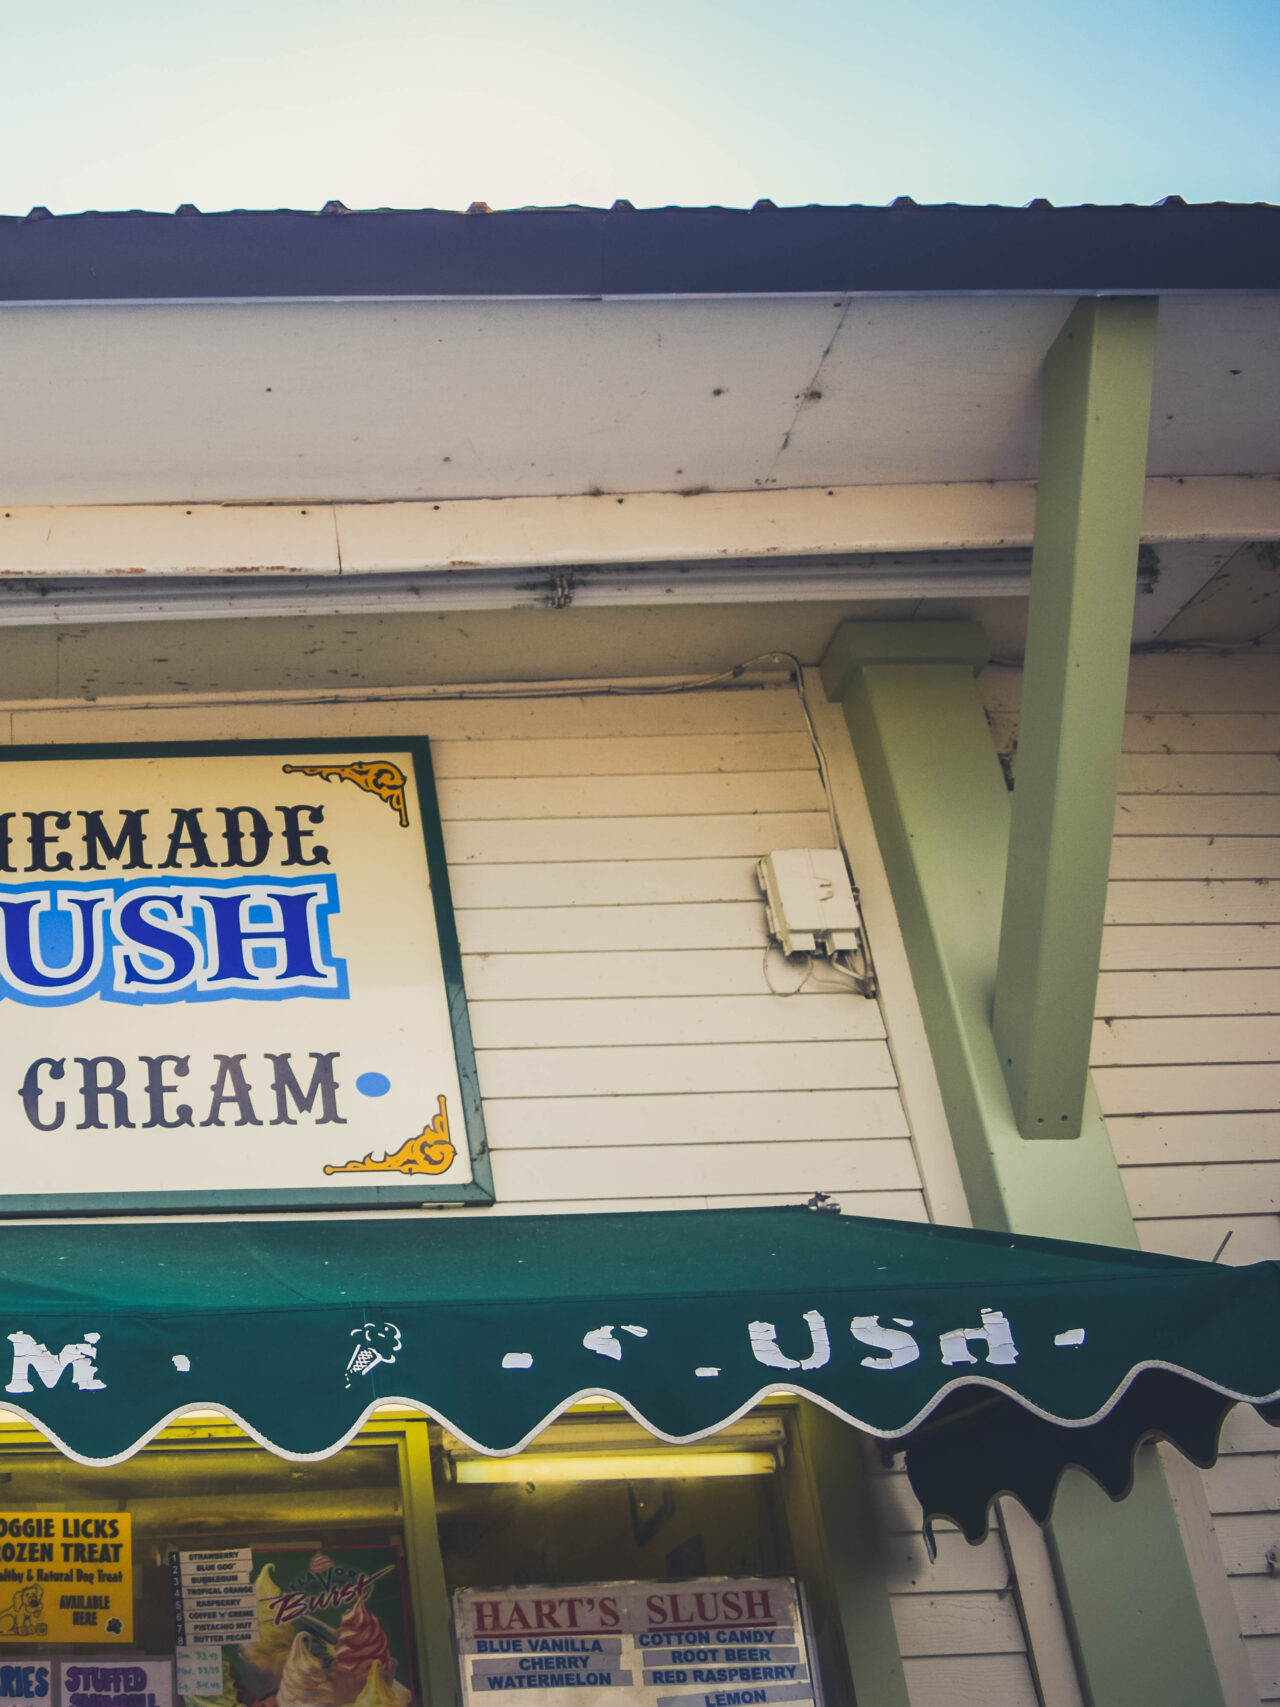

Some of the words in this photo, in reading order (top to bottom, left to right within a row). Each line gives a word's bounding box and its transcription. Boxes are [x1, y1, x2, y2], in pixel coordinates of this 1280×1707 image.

[17, 1051, 348, 1132] CREAM
[62, 1518, 120, 1539] LICKS
[60, 1543, 123, 1563] TREAT
[188, 1551, 239, 1561] STRAWBERRY
[26, 1568, 34, 1582] &
[36, 1568, 74, 1583] Natural
[76, 1569, 94, 1585] Dog
[97, 1569, 123, 1583] Treat
[187, 1587, 222, 1596] TROPICAL
[223, 1586, 253, 1594] ORANGE
[269, 1564, 394, 1625] Burst
[59, 1595, 110, 1610] AVAILABLE
[196, 1599, 241, 1608] RASPBERRY
[473, 1597, 620, 1631] HART'S
[646, 1590, 774, 1625] SLUSH
[72, 1611, 98, 1626] HERE
[188, 1611, 217, 1620] COFFEE
[228, 1610, 254, 1618] CREME
[193, 1623, 234, 1632] PISTACHIO
[193, 1635, 224, 1643] BUTTER
[226, 1633, 252, 1641] PECAN
[477, 1639, 523, 1653] BLUE
[528, 1639, 604, 1653] VANILLA
[639, 1631, 711, 1647] COTTON
[716, 1630, 776, 1644] CANDY
[519, 1655, 590, 1671] CHERRY
[672, 1649, 719, 1664] ROOT
[725, 1648, 772, 1662] BEER
[65, 1666, 148, 1693] STUFFED
[487, 1672, 612, 1689] WATERMELON
[652, 1670, 688, 1684] RED
[693, 1665, 797, 1683] RASPBERRY
[705, 1689, 767, 1707] LEMON
